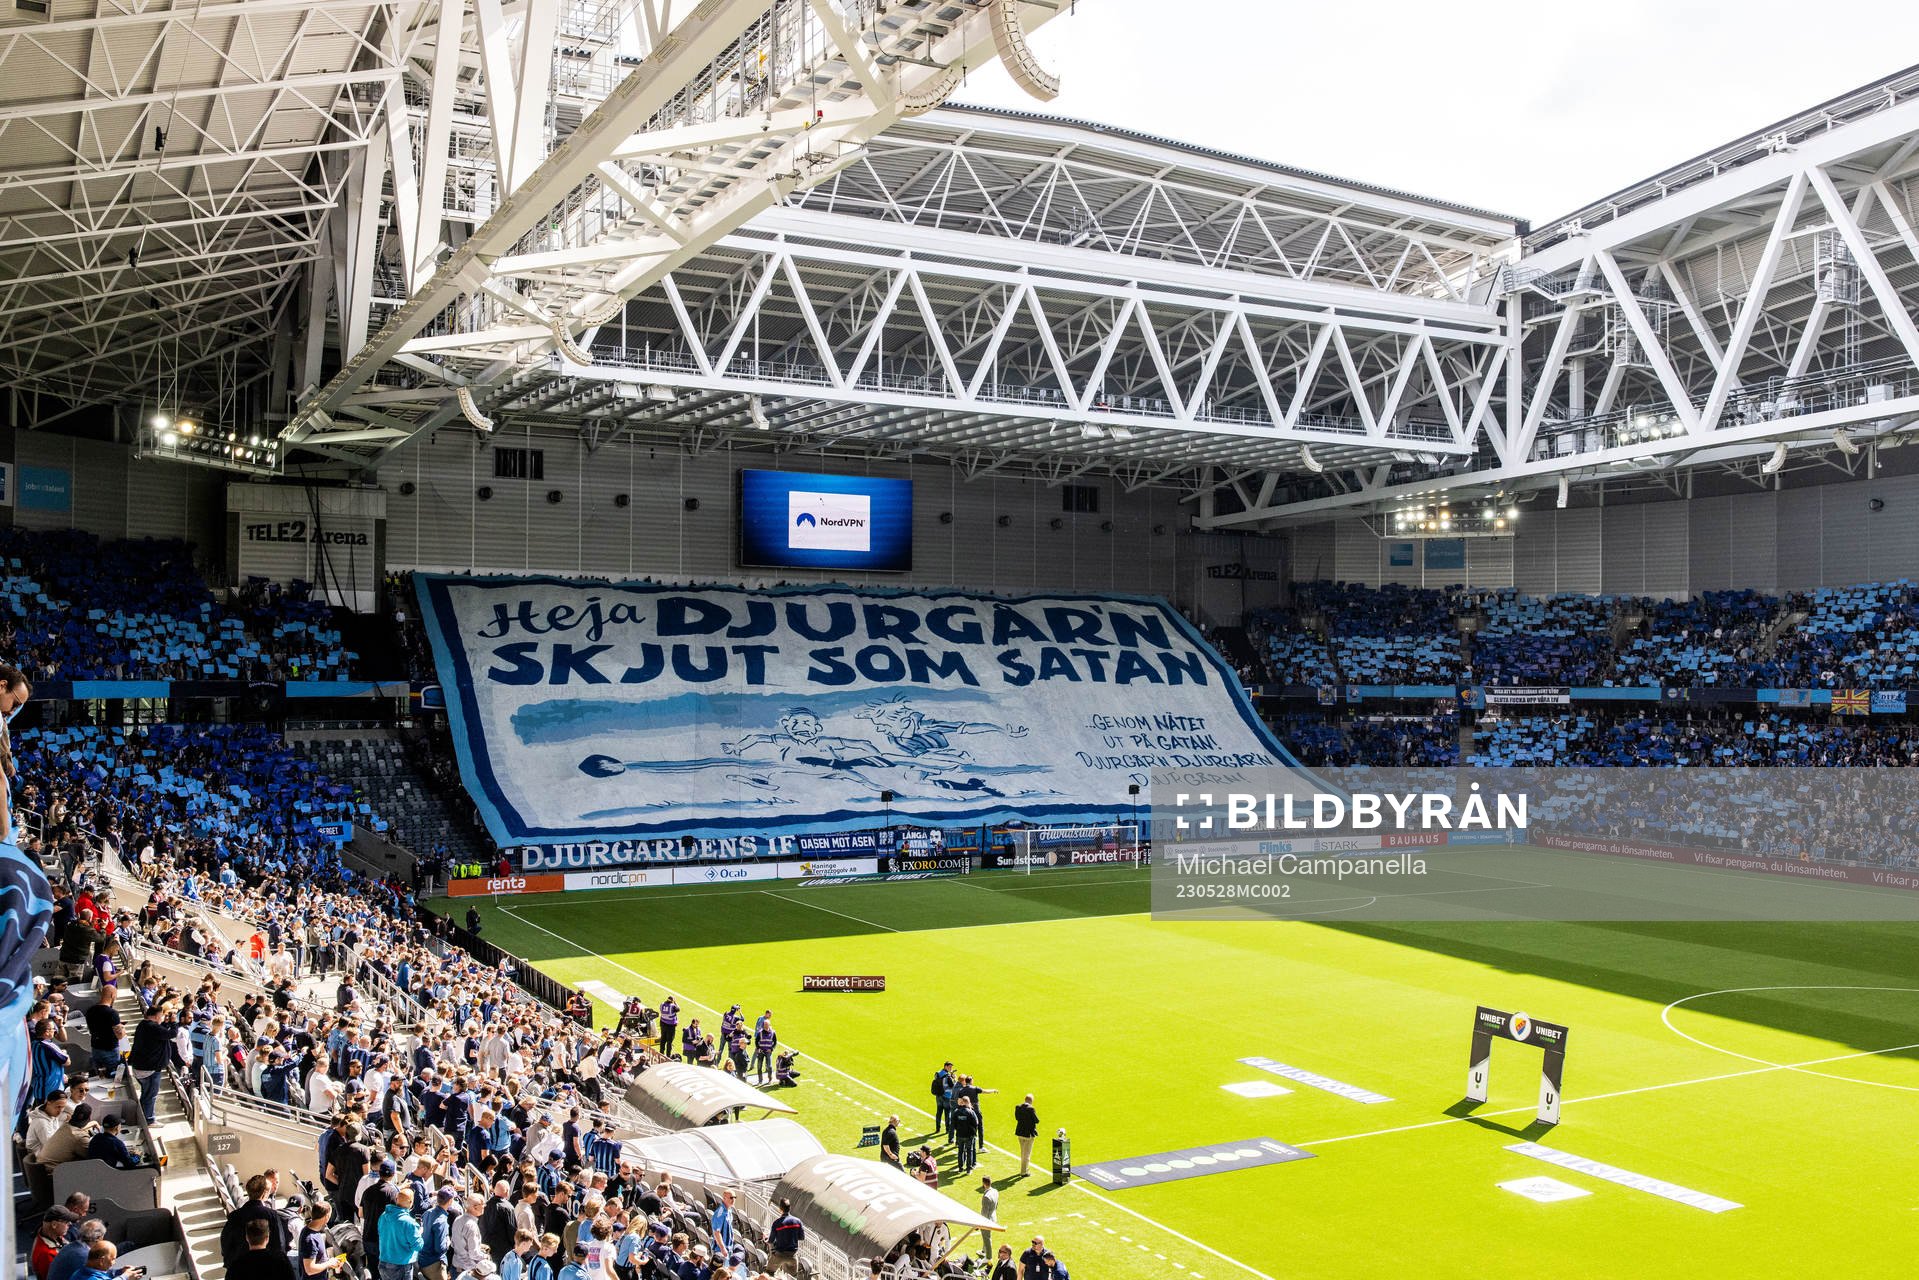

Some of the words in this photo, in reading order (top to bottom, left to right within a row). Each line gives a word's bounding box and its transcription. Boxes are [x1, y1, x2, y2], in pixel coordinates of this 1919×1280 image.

[820, 517, 864, 528] NordVPN
[246, 521, 306, 543] TELE2
[310, 527, 368, 546] Arena
[1206, 562, 1241, 579] TELE2
[1244, 568, 1278, 582] Arena
[477, 597, 647, 641] Heja
[488, 642, 780, 685] SKJUT
[807, 645, 980, 687] SOM
[1000, 647, 1208, 687] SATAN
[1153, 712, 1205, 732] NÄTET
[1103, 736, 1124, 749] UT
[1130, 734, 1157, 749] PÅ
[1157, 734, 1222, 751] GATAN!
[831, 836, 850, 848] MOT
[852, 835, 876, 847] ASEN
[902, 830, 928, 840] LÅNGA
[1390, 834, 1439, 846] BAUHAUS
[768, 835, 796, 855] IF
[1259, 841, 1293, 853] Flinks
[1321, 840, 1358, 850] STARK
[1545, 836, 1554, 845] Vi
[1555, 838, 1571, 848] fixar
[1573, 841, 1608, 852] pengarna,
[1610, 844, 1620, 853] du
[1622, 845, 1674, 859] lönsamheten.
[997, 854, 1045, 866] Sundström
[1071, 849, 1118, 863] Prioritet
[902, 857, 962, 871] FXORO.COM
[1694, 852, 1703, 863] Vi
[1705, 853, 1724, 865] fixar
[1726, 857, 1768, 871] pengarna,
[1771, 861, 1783, 872] du
[1785, 863, 1848, 879] lönsamheten.
[591, 871, 647, 886] nordicpm
[720, 868, 748, 879] Ocab
[1873, 872, 1883, 883] Vi
[1886, 873, 1910, 885] fixar
[487, 876, 526, 891] renta
[804, 976, 849, 987] Prioritet
[851, 977, 885, 987] Finans
[1480, 1012, 1506, 1026] UNIBET
[1535, 1025, 1562, 1039] UNIBET
[1475, 1072, 1482, 1083] U
[656, 1065, 728, 1106] UNIBET
[1546, 1093, 1553, 1105] U
[812, 1158, 931, 1220] UNIBET
